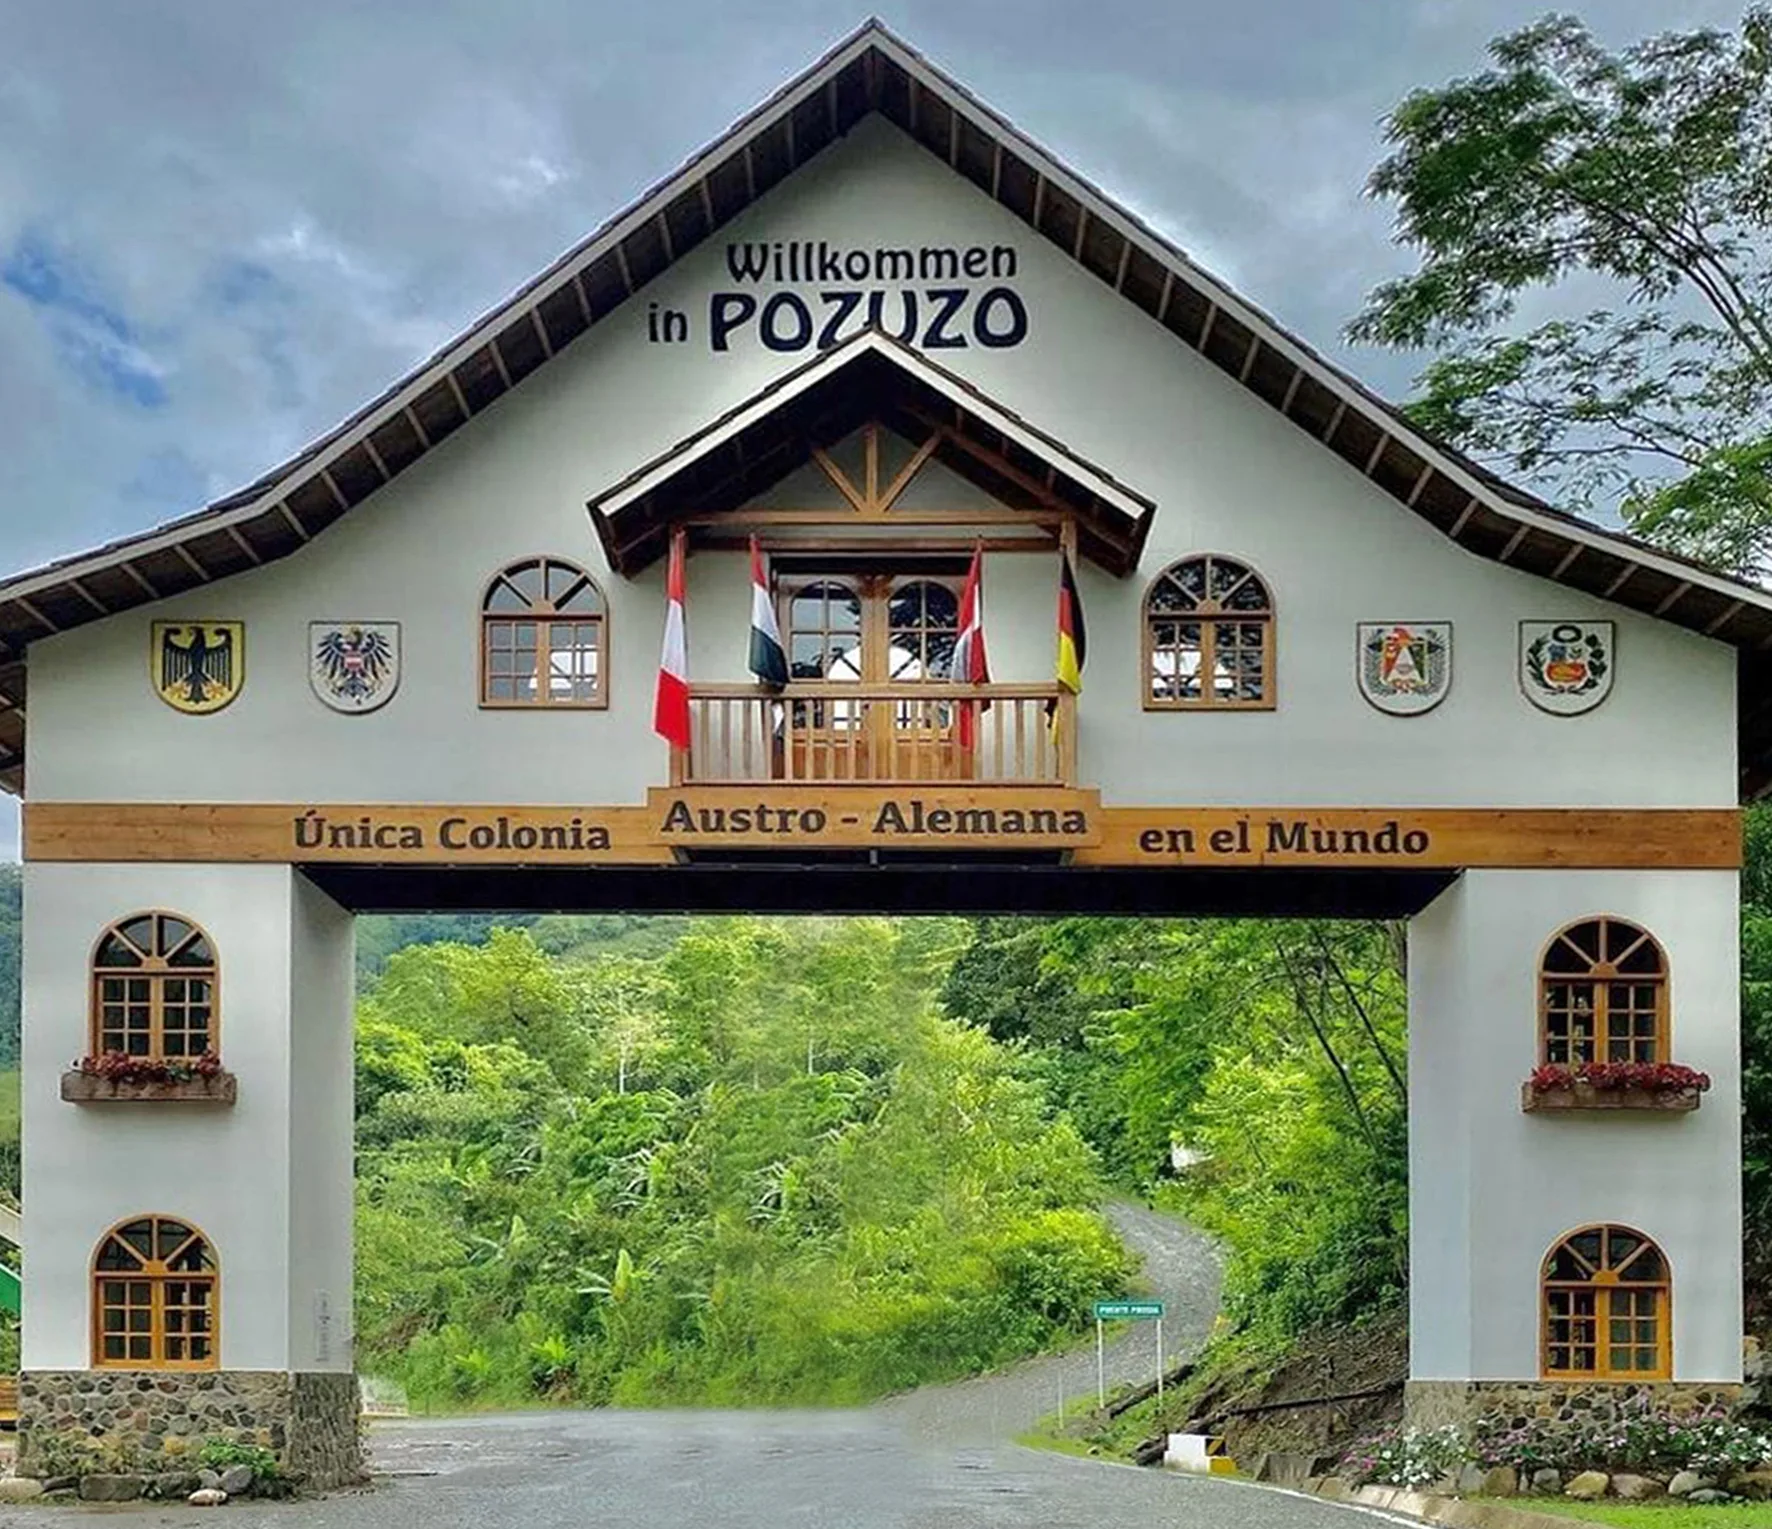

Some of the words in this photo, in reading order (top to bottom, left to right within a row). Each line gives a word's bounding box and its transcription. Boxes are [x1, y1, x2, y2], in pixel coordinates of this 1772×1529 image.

[727, 242, 1017, 282] Willkommen
[648, 303, 687, 342] in
[710, 286, 1028, 352] POZUZO
[293, 810, 424, 849] Única
[437, 816, 611, 850] Colonia
[660, 800, 827, 833] Austro
[871, 801, 1087, 834] Alemana
[1139, 825, 1194, 852] en
[1209, 815, 1251, 853] el
[1265, 821, 1430, 854] Mundo
